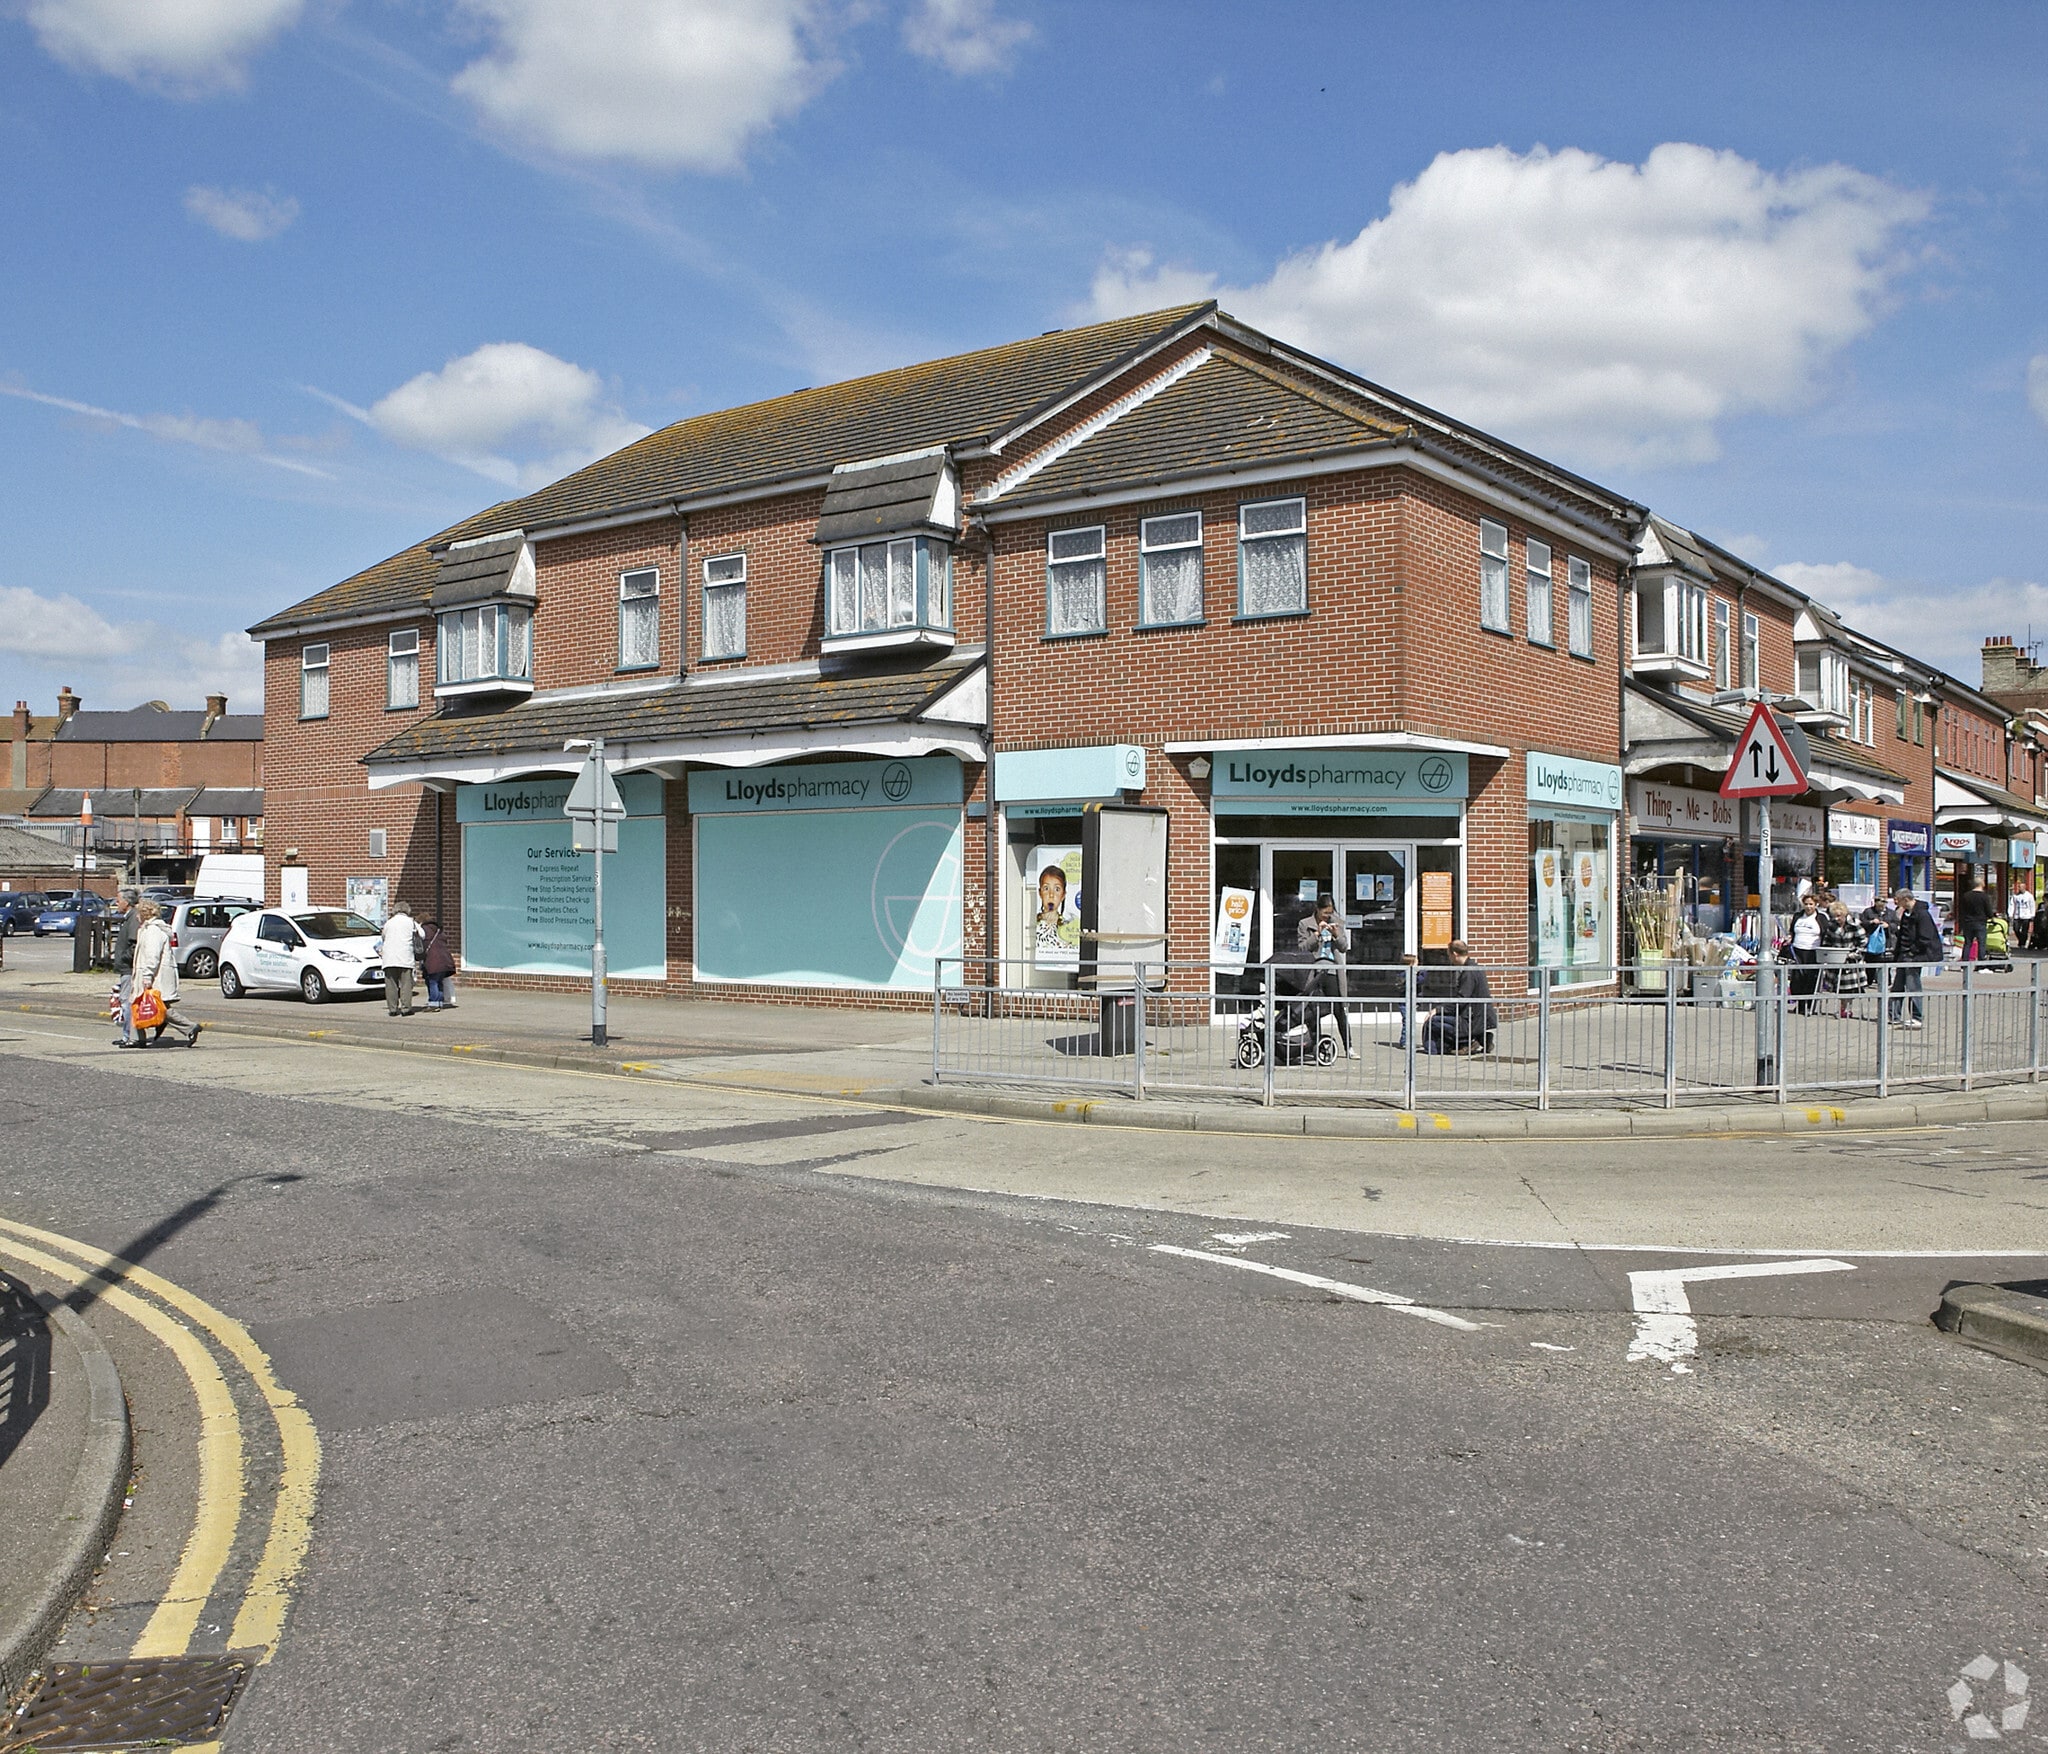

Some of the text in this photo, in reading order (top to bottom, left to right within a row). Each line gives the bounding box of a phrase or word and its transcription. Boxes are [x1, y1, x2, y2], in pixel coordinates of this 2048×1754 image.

[1230, 763, 1406, 790] Lloydspharmacy
[1537, 766, 1604, 799] Lloydspharmacy
[484, 790, 569, 815] Lloydspharm
[726, 778, 870, 804] Lloydspharmacy
[1024, 806, 1083, 814] www.lloydspharma
[1291, 804, 1388, 814] www.lloydspharmacy.com
[1646, 791, 1672, 826] Thing
[1686, 797, 1700, 820] Me
[1712, 800, 1732, 824] Bobs
[1831, 814, 1842, 838] hing
[527, 847, 581, 858] Our Services
[1942, 837, 1970, 848] Argos
